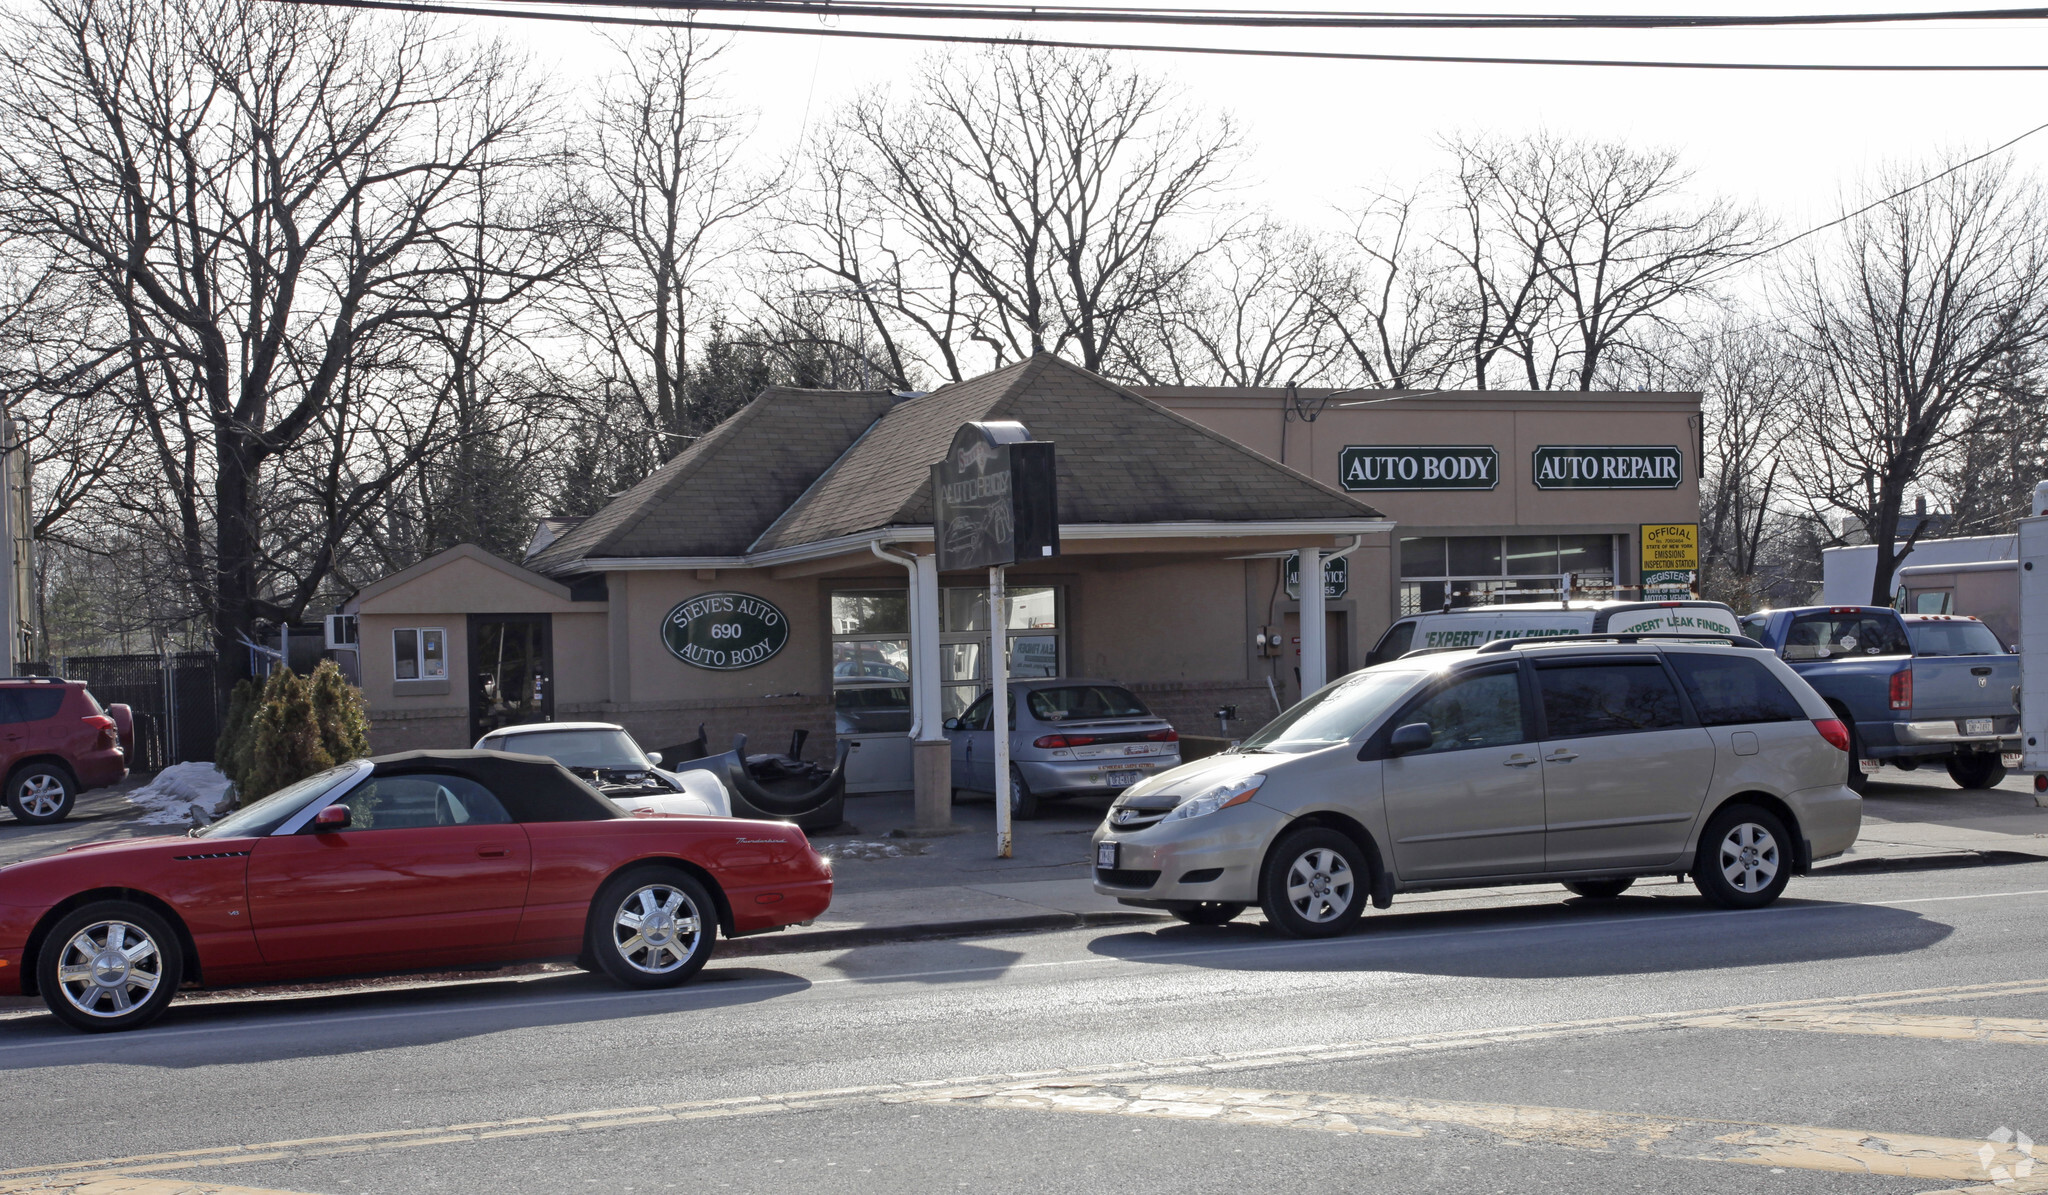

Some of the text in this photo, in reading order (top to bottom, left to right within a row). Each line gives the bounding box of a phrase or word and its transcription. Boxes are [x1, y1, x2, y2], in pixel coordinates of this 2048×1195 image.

[1347, 456, 1492, 480] AUTO BODY
[1539, 456, 1677, 480] AUTO REPAIR
[1648, 526, 1691, 541] OFFICIAL
[1654, 550, 1686, 559] EMISSIONS
[1644, 559, 1696, 569] INSPECTION STATION
[1646, 571, 1689, 585] REGISTER
[673, 597, 778, 628] STEVE'S AUTO
[711, 623, 742, 639] 690
[1667, 617, 1695, 627] LEAK
[1697, 618, 1731, 634] FINDER
[680, 637, 773, 666] AUTO BODY
